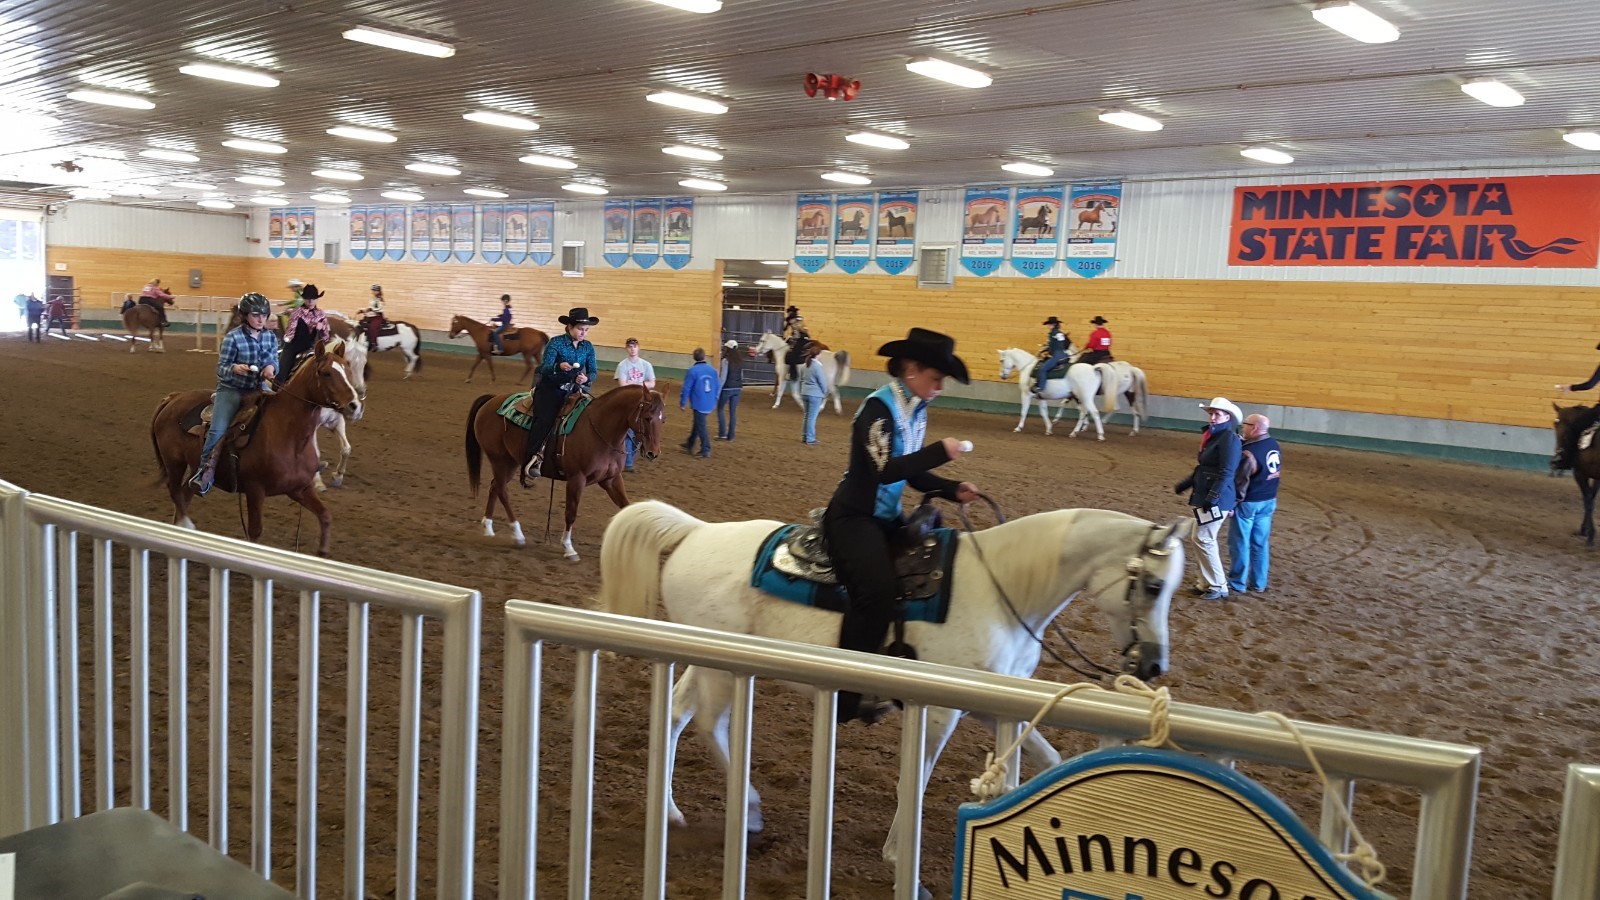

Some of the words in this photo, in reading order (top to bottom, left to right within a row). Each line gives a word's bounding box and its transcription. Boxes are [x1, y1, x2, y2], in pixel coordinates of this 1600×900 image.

[1240, 182, 1513, 221] MINNESOTA
[1237, 225, 1386, 262] STATE
[1394, 224, 1530, 262] FAIR
[803, 259, 819, 267] 2015
[843, 259, 860, 267] 2015
[885, 260, 904, 268] 2015
[971, 261, 992, 269] 2016
[1022, 262, 1045, 270] 2016
[1078, 261, 1101, 270] 2016
[989, 816, 1316, 900] Minneso
